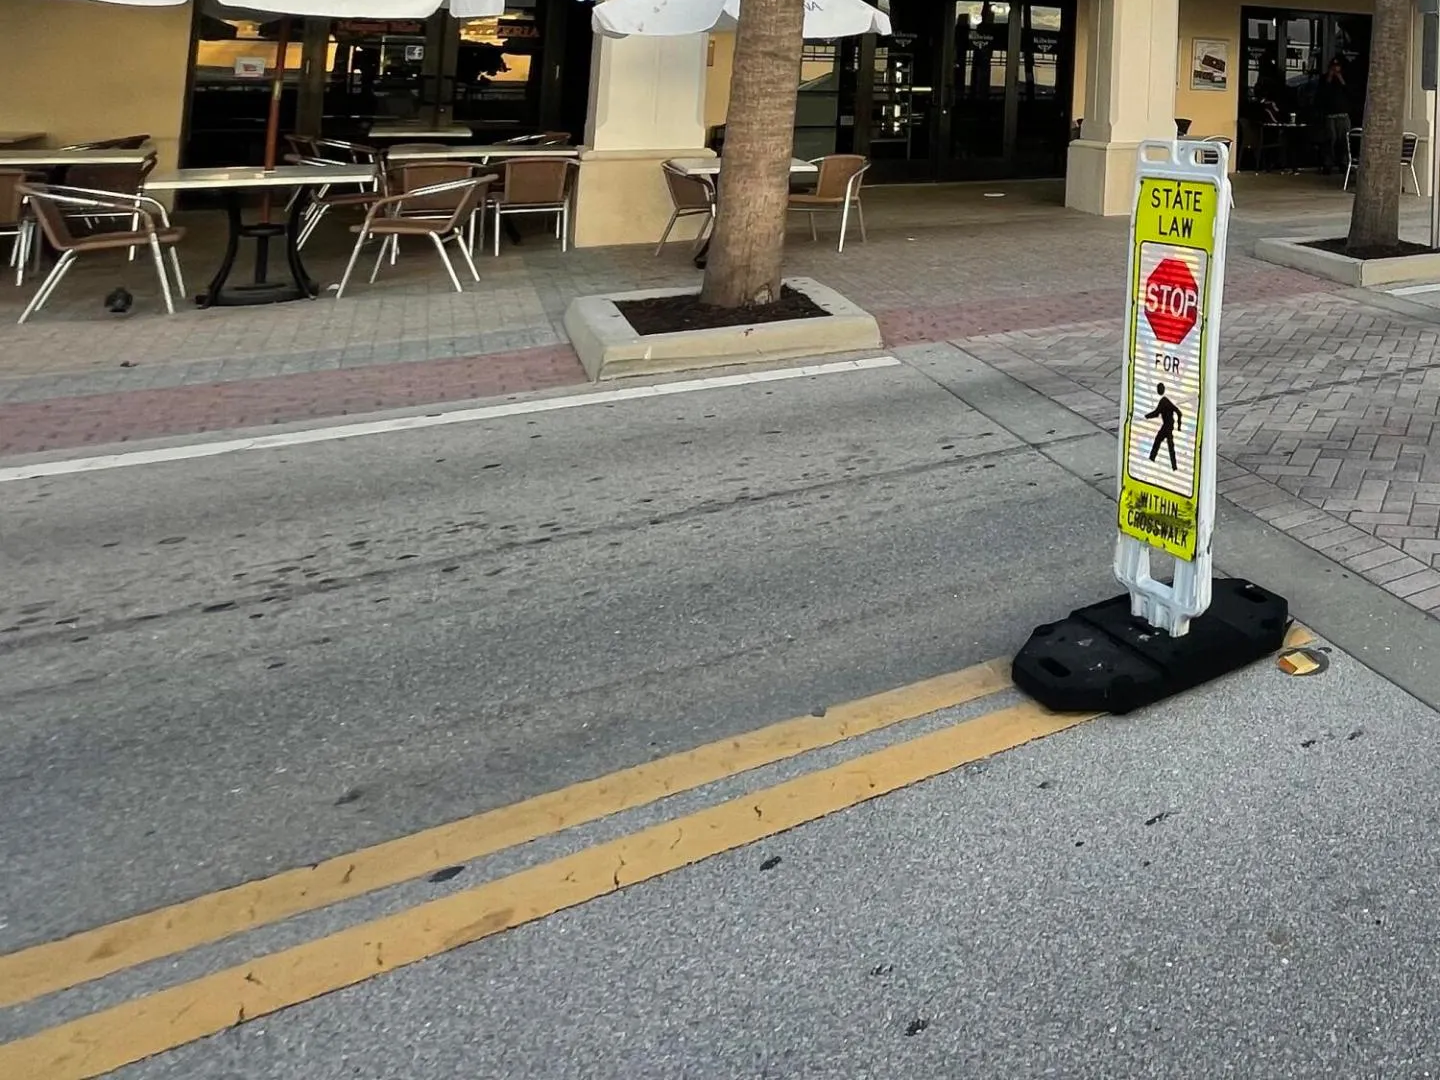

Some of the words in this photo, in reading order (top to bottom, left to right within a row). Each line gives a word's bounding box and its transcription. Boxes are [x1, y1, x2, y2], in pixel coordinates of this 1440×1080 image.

[1151, 187, 1203, 212] STATE
[1158, 215, 1194, 239] LAW
[1146, 283, 1198, 318] STOP
[1155, 353, 1180, 375] FOR
[1139, 491, 1179, 520] WITHIN
[1127, 508, 1189, 548] CROSSWALK
